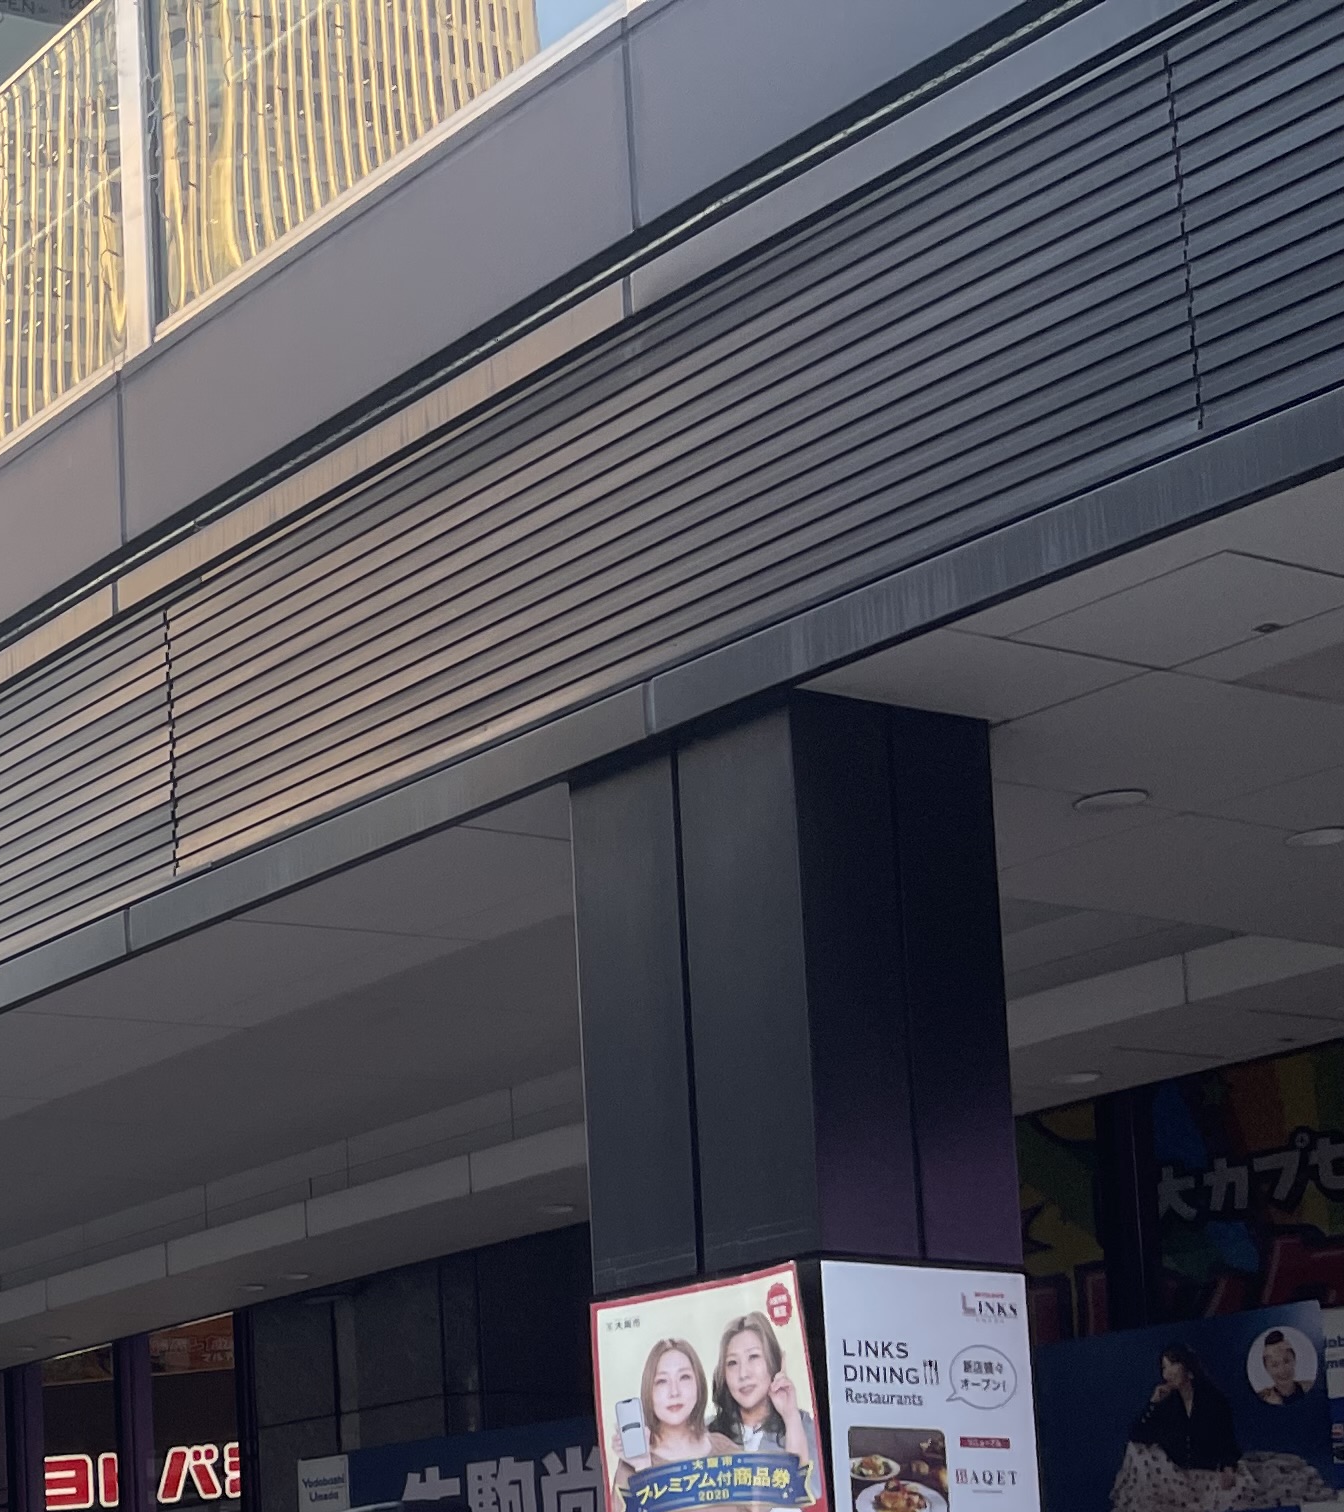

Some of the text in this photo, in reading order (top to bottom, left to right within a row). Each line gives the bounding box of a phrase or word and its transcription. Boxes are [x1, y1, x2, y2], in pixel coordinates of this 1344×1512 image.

[841, 1339, 909, 1359] LINKS
[843, 1364, 920, 1385] DINING
[845, 1388, 924, 1406] Restaurants
[636, 1468, 791, 1506] プレミアム付商品券
[955, 1468, 1019, 1486] BAQET
